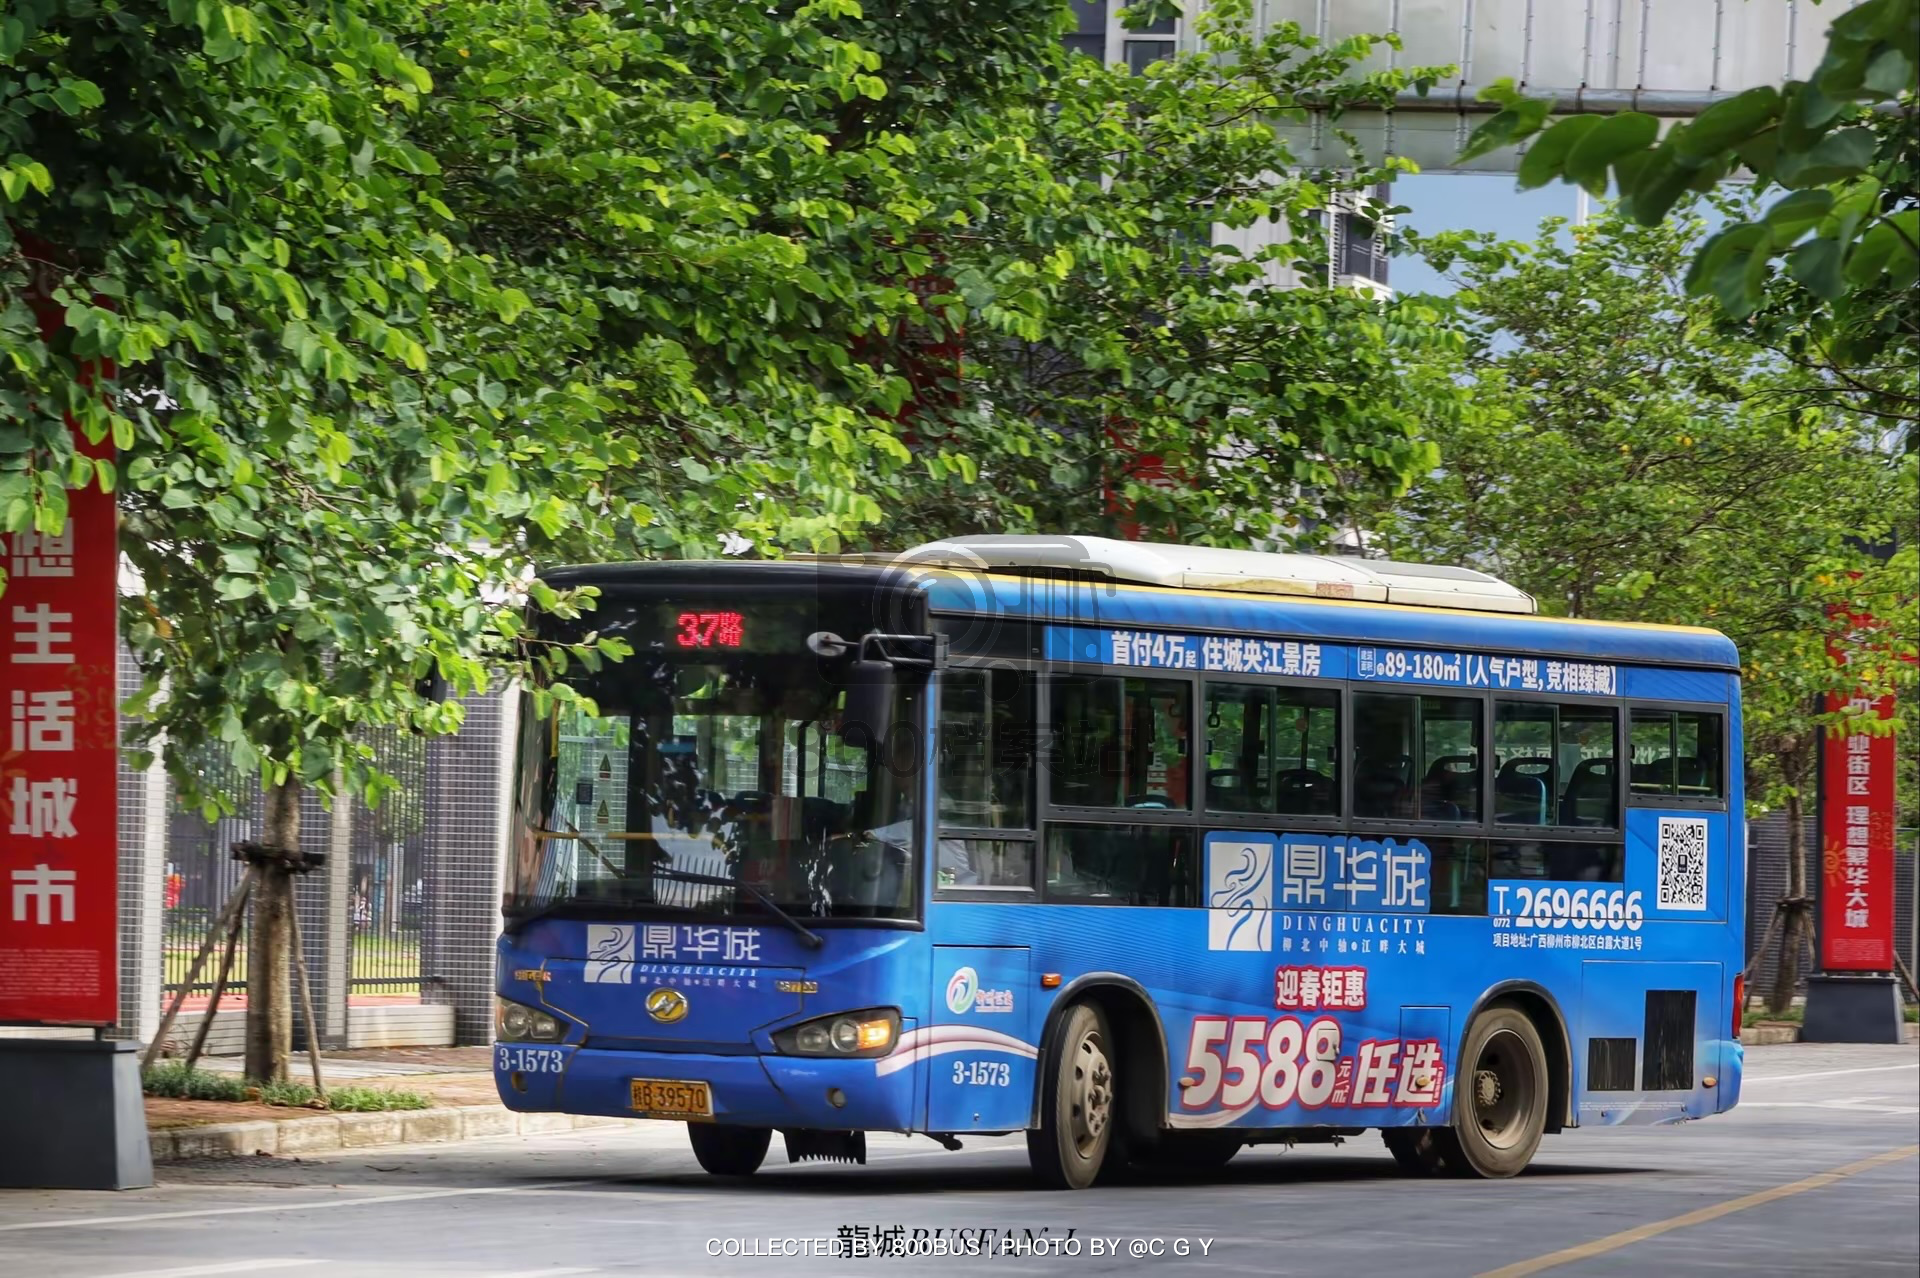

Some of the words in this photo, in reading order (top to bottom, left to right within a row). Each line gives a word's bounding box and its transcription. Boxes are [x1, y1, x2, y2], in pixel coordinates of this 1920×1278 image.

[677, 612, 743, 646] 37路
[1111, 631, 1197, 668] 首付4万起
[1202, 637, 1321, 677] 住城央江景房
[9, 430, 78, 925] 想生活城市
[1283, 844, 1426, 907] 鼎华城
[1283, 915, 1425, 934] DINGHUACITY
[1493, 918, 1510, 928] 0772
[1516, 887, 1643, 931] 2696666
[642, 925, 761, 961] 鼎华城
[640, 964, 759, 978] DINGHUACITY
[1276, 969, 1365, 1007] 迎春钜惠
[500, 1047, 563, 1073] 3-1573
[952, 1061, 1010, 1086] 3-1573
[1182, 1019, 1338, 1106] 5588
[1352, 1042, 1440, 1104] 任选
